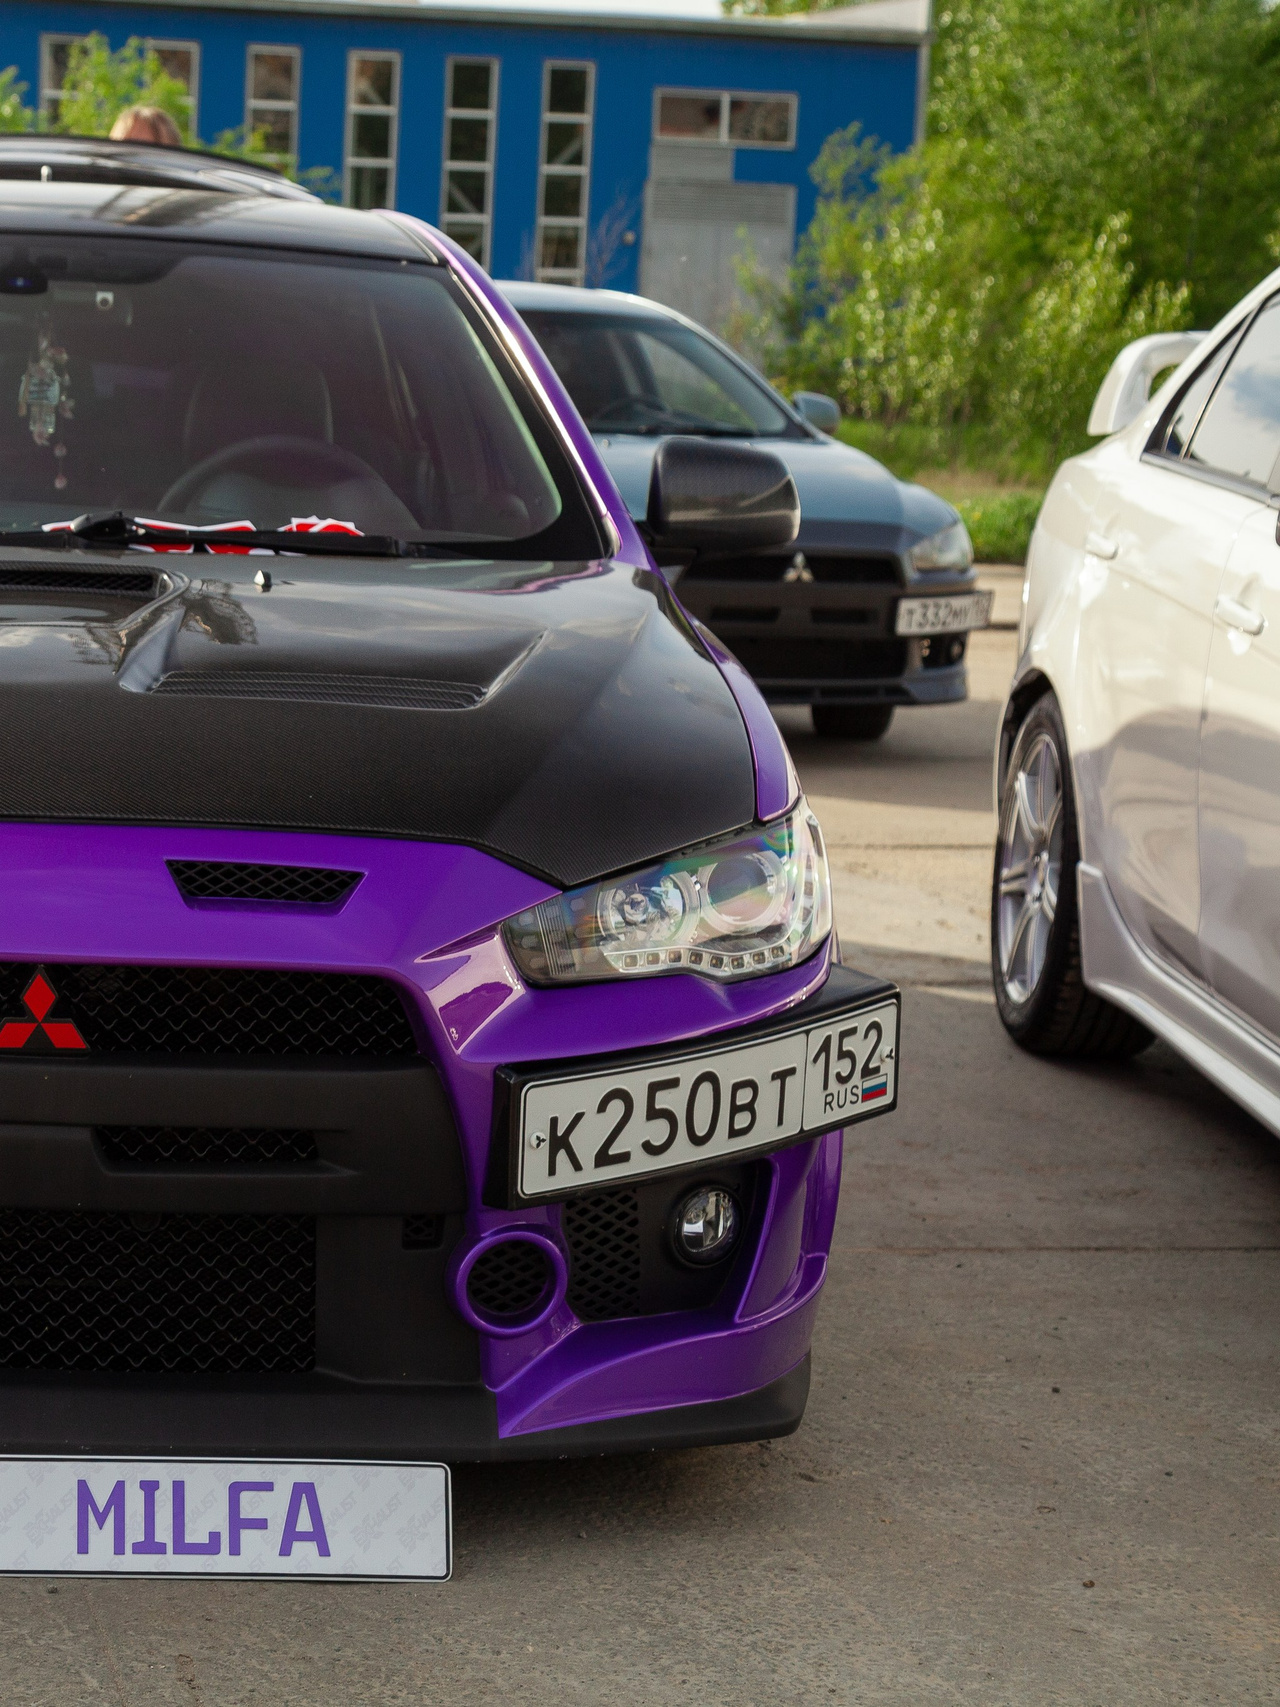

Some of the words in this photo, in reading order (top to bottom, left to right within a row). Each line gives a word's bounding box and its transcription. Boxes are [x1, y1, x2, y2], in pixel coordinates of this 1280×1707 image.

[811, 1020, 884, 1092] 152
[823, 1083, 860, 1114] RUS
[76, 1479, 331, 1557] MILFA
